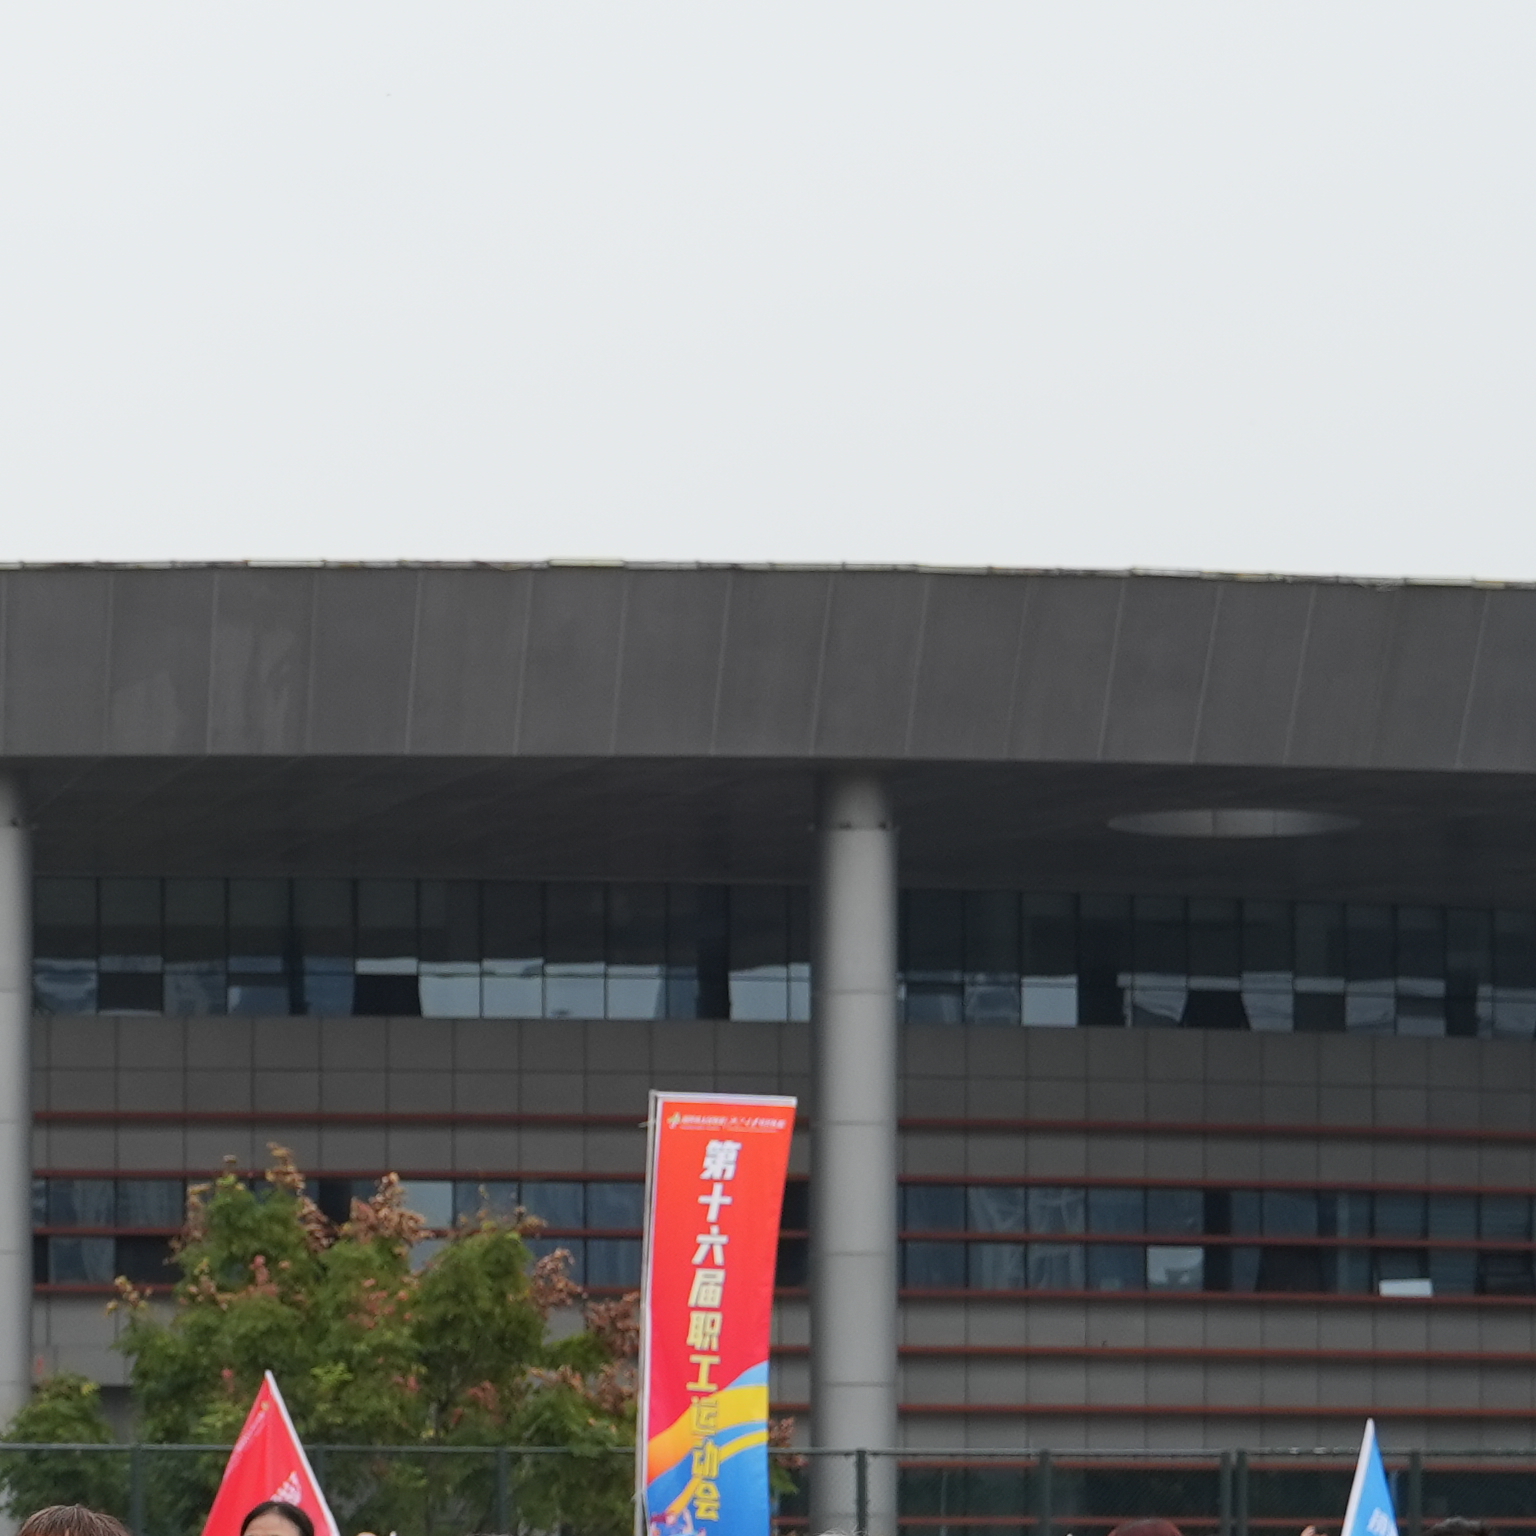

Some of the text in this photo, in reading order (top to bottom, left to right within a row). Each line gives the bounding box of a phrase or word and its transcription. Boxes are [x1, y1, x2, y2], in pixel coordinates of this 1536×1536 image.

[685, 1139, 742, 1520] 第十六届职工运动会
